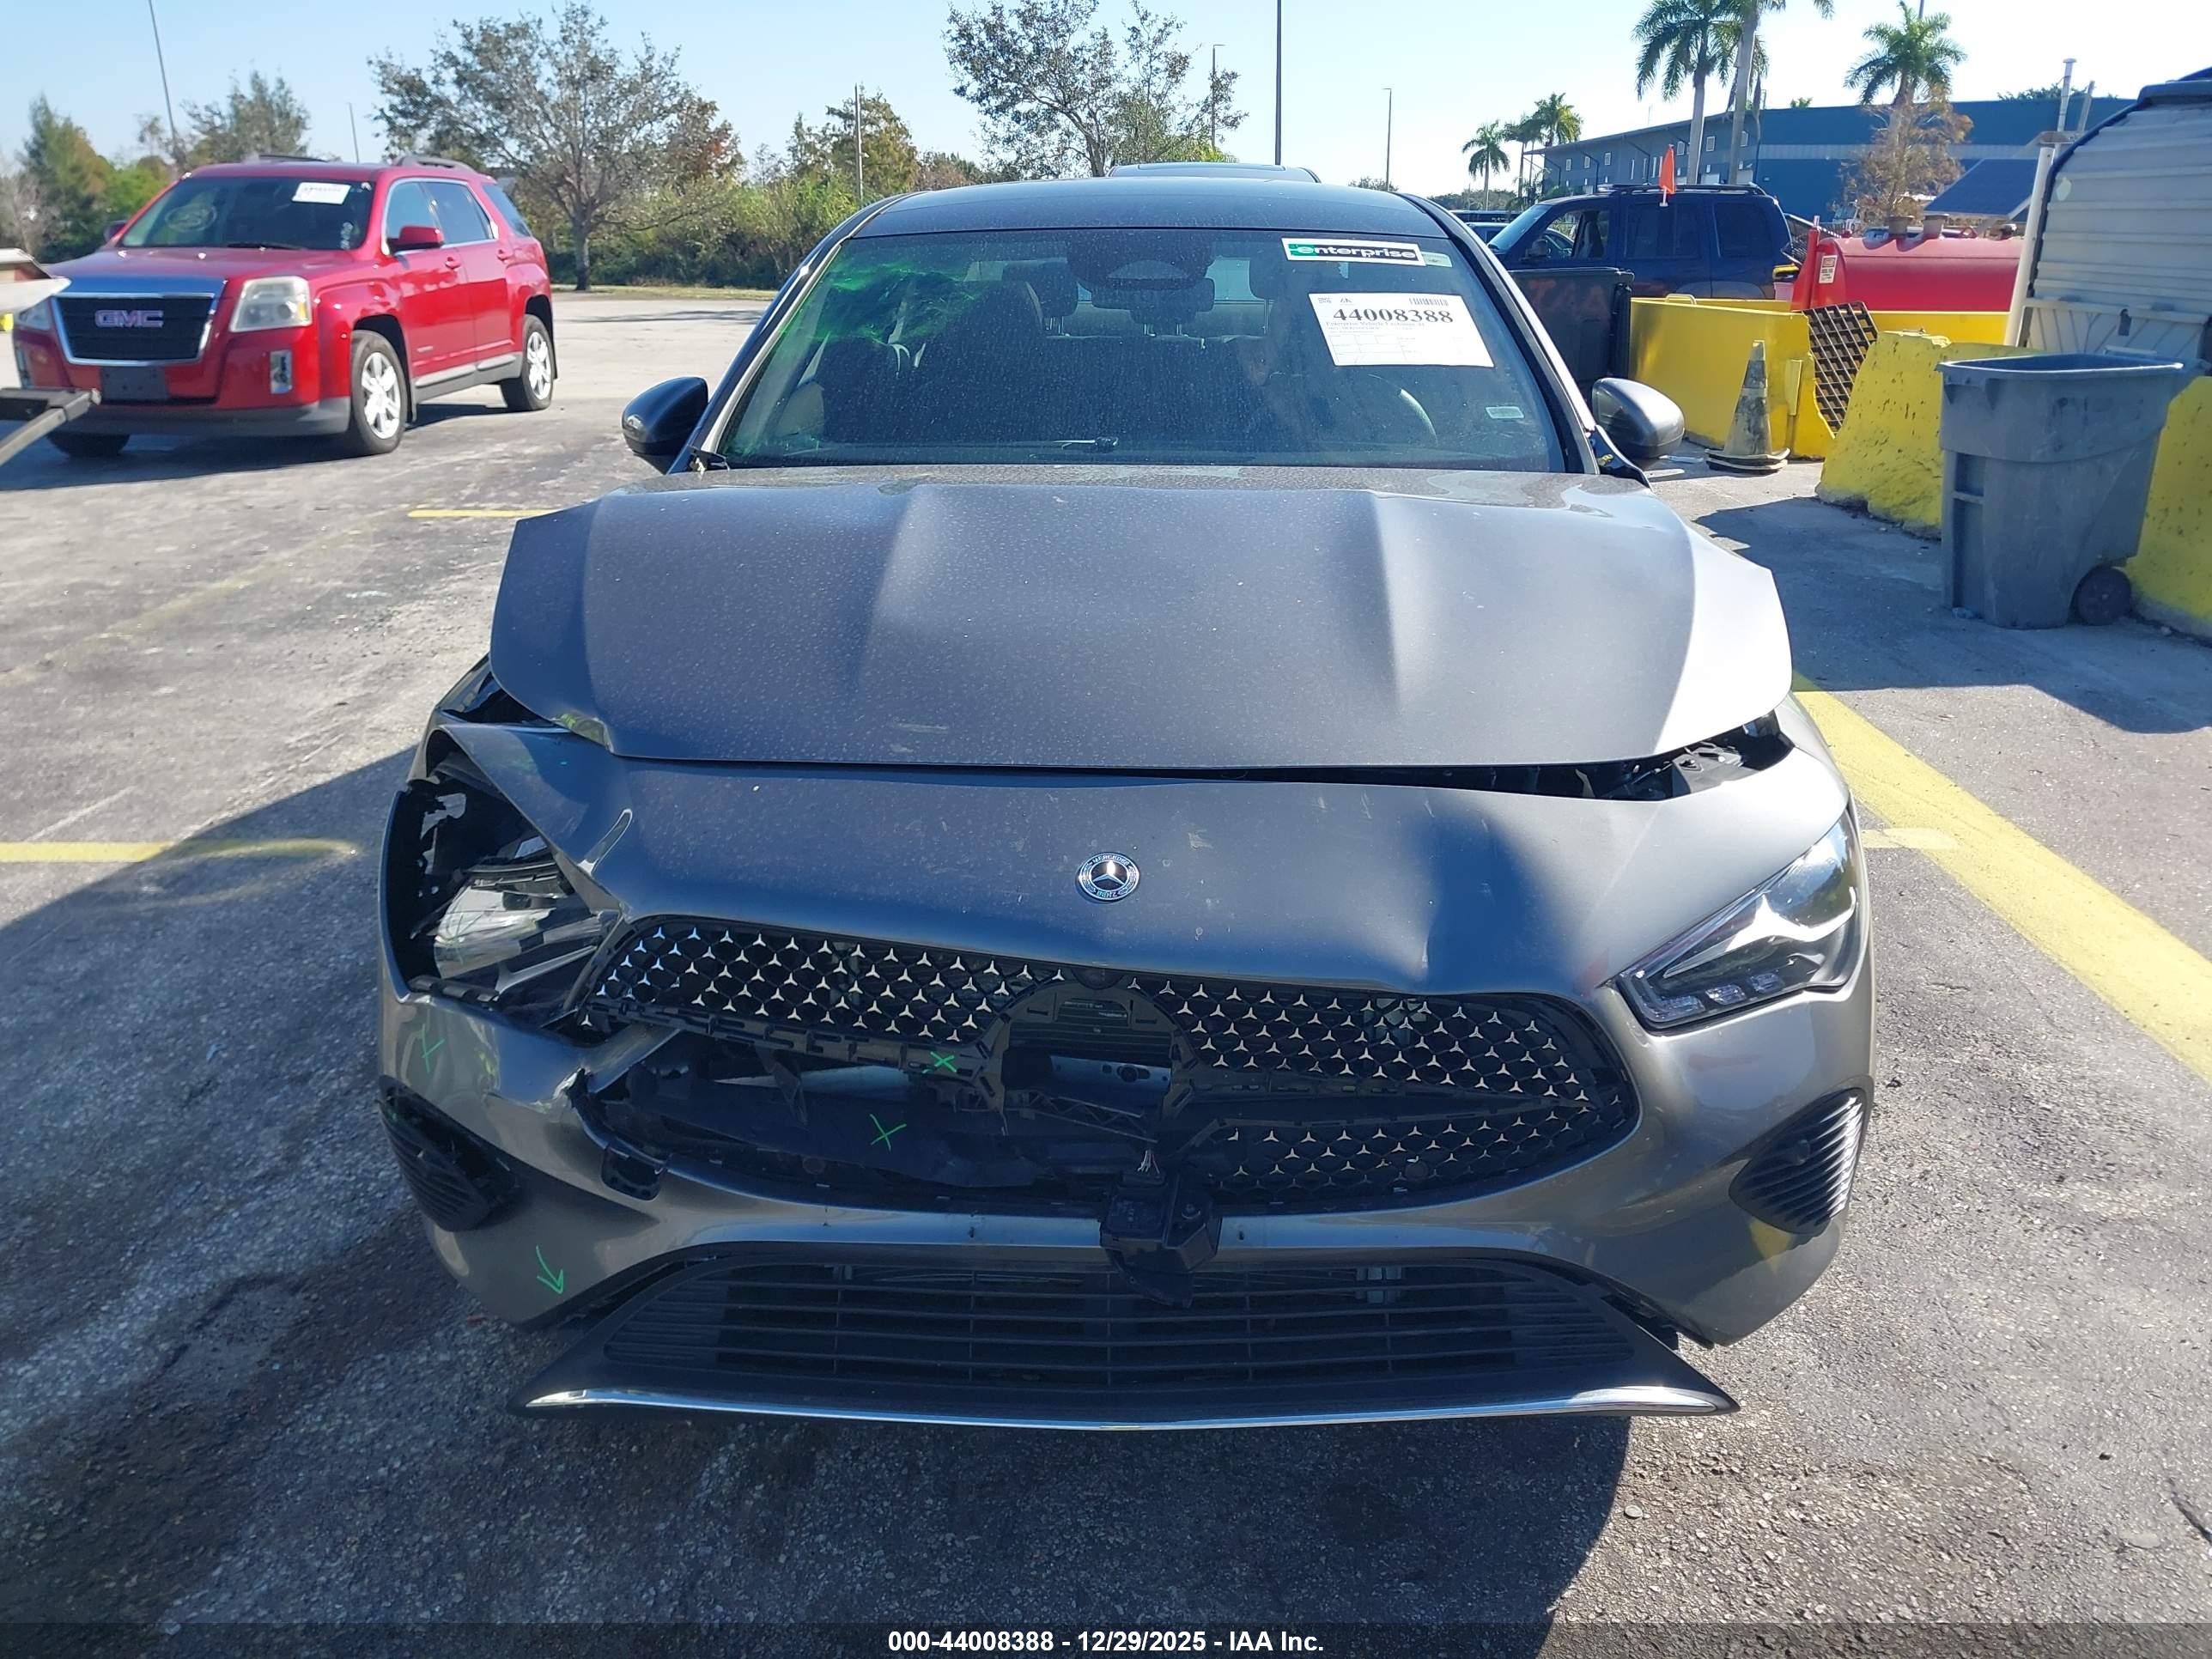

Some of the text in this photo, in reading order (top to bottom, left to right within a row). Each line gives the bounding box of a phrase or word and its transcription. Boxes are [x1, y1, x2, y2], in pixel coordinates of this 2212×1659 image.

[1297, 246, 1416, 258] enterprise
[94, 309, 164, 328] GMC
[1333, 308, 1455, 324] 44008388
